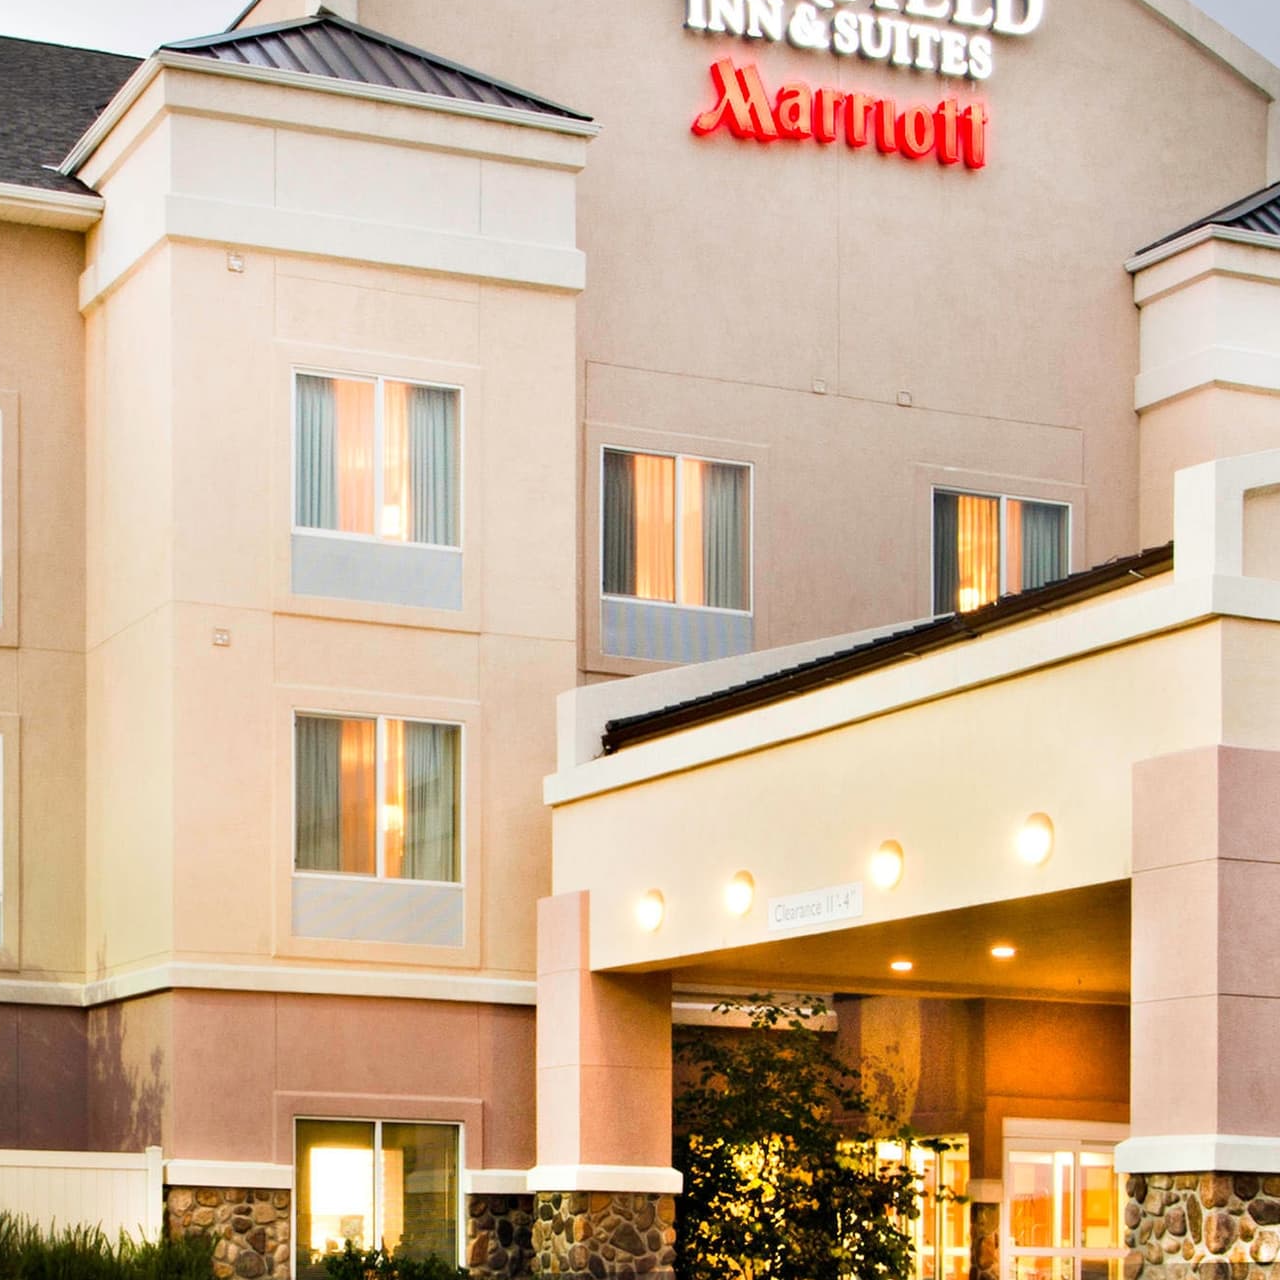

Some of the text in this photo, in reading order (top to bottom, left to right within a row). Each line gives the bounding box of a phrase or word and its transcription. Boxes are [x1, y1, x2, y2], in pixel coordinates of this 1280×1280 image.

[787, 2, 830, 51] &
[832, 10, 993, 81] SUITES
[691, 57, 987, 170] Marriott
[774, 902, 822, 923] Clearance
